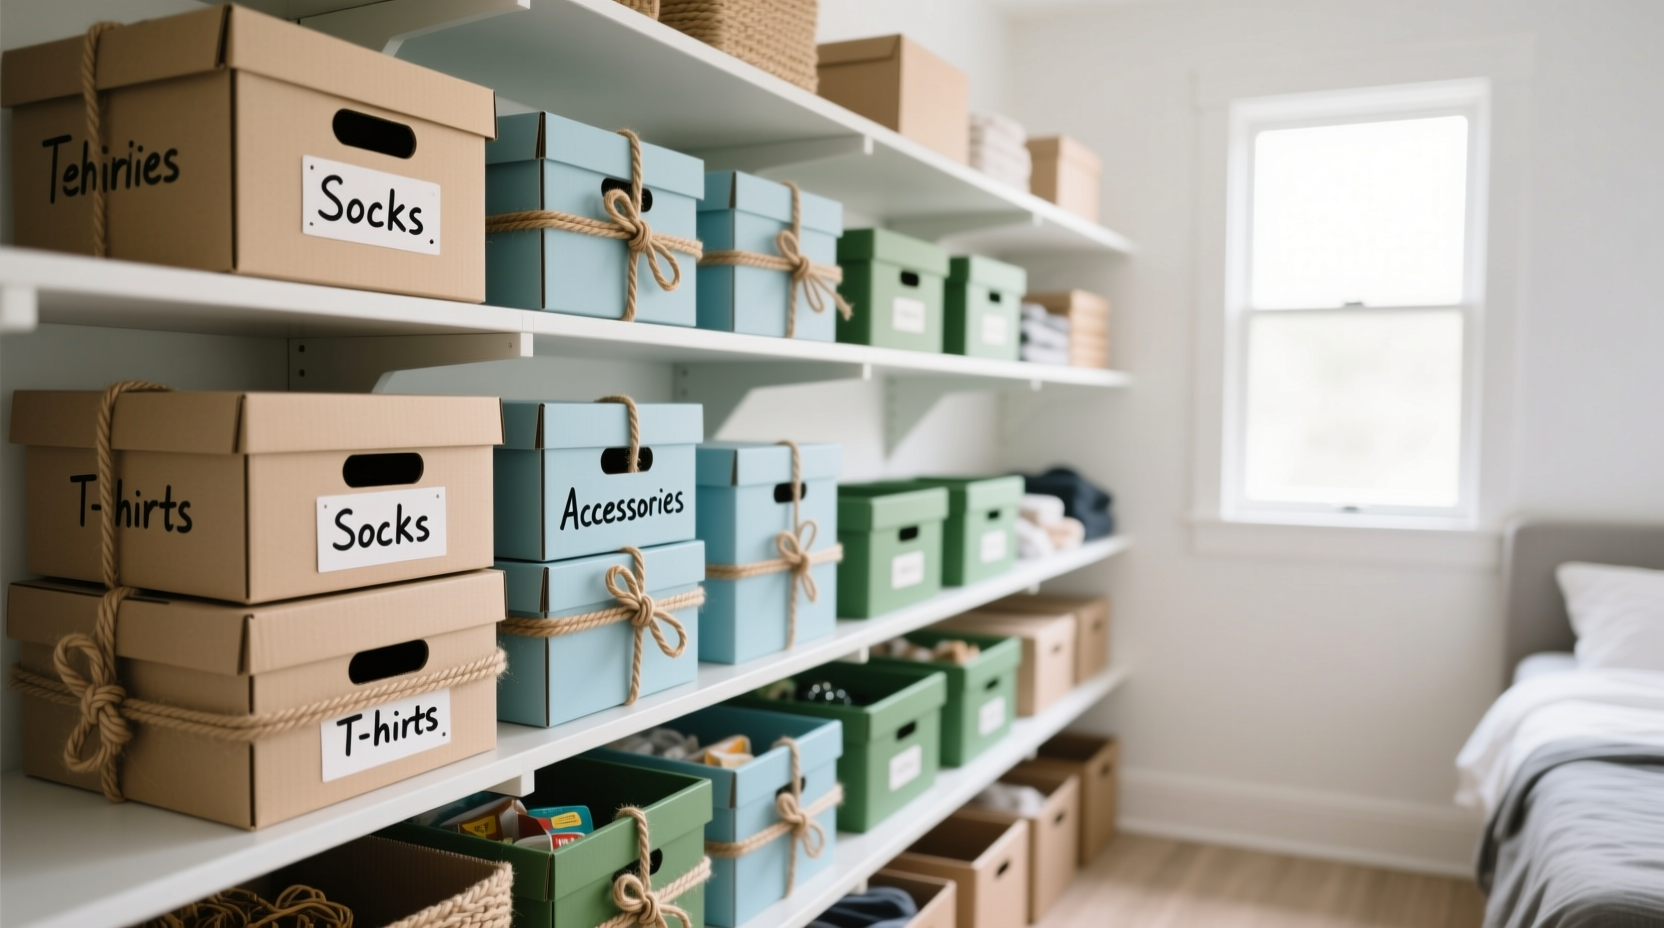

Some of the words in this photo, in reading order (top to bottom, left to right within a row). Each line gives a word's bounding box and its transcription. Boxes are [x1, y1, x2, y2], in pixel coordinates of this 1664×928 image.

[317, 174, 424, 236] Socks
[332, 503, 430, 551] Socks
[560, 486, 685, 531] Accessories
[336, 705, 439, 757] T-hirts
